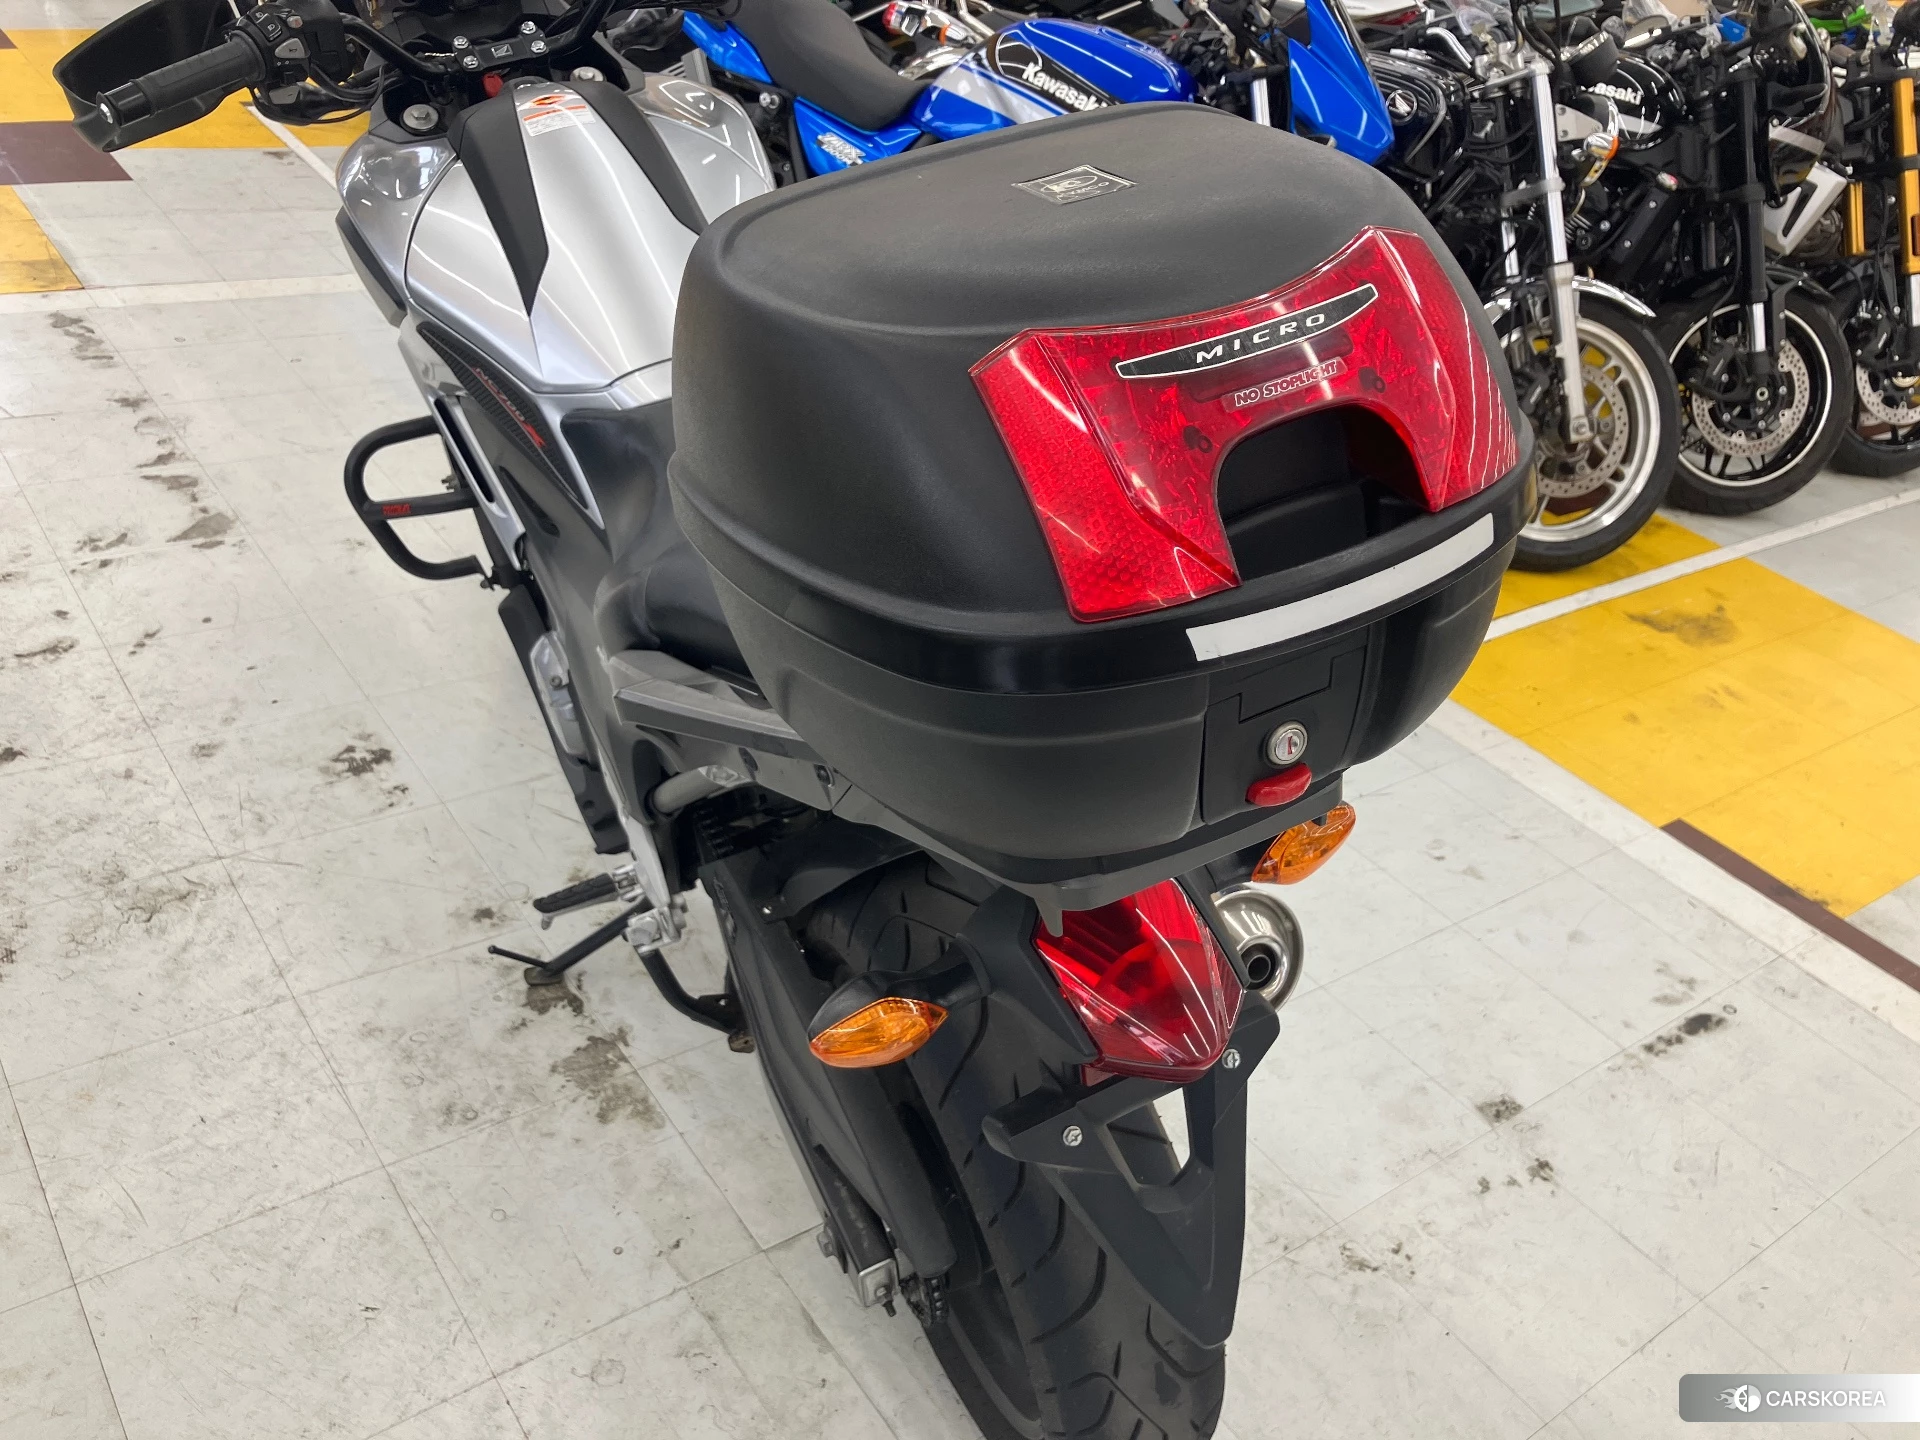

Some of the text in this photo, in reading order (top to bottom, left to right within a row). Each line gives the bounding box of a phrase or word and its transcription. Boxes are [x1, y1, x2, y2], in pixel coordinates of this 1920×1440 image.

[1021, 61, 1108, 111] Kawasak
[1580, 82, 1642, 105] asaki
[1196, 313, 1325, 363] MICRO
[1234, 360, 1337, 407] NO STOPLIGHT
